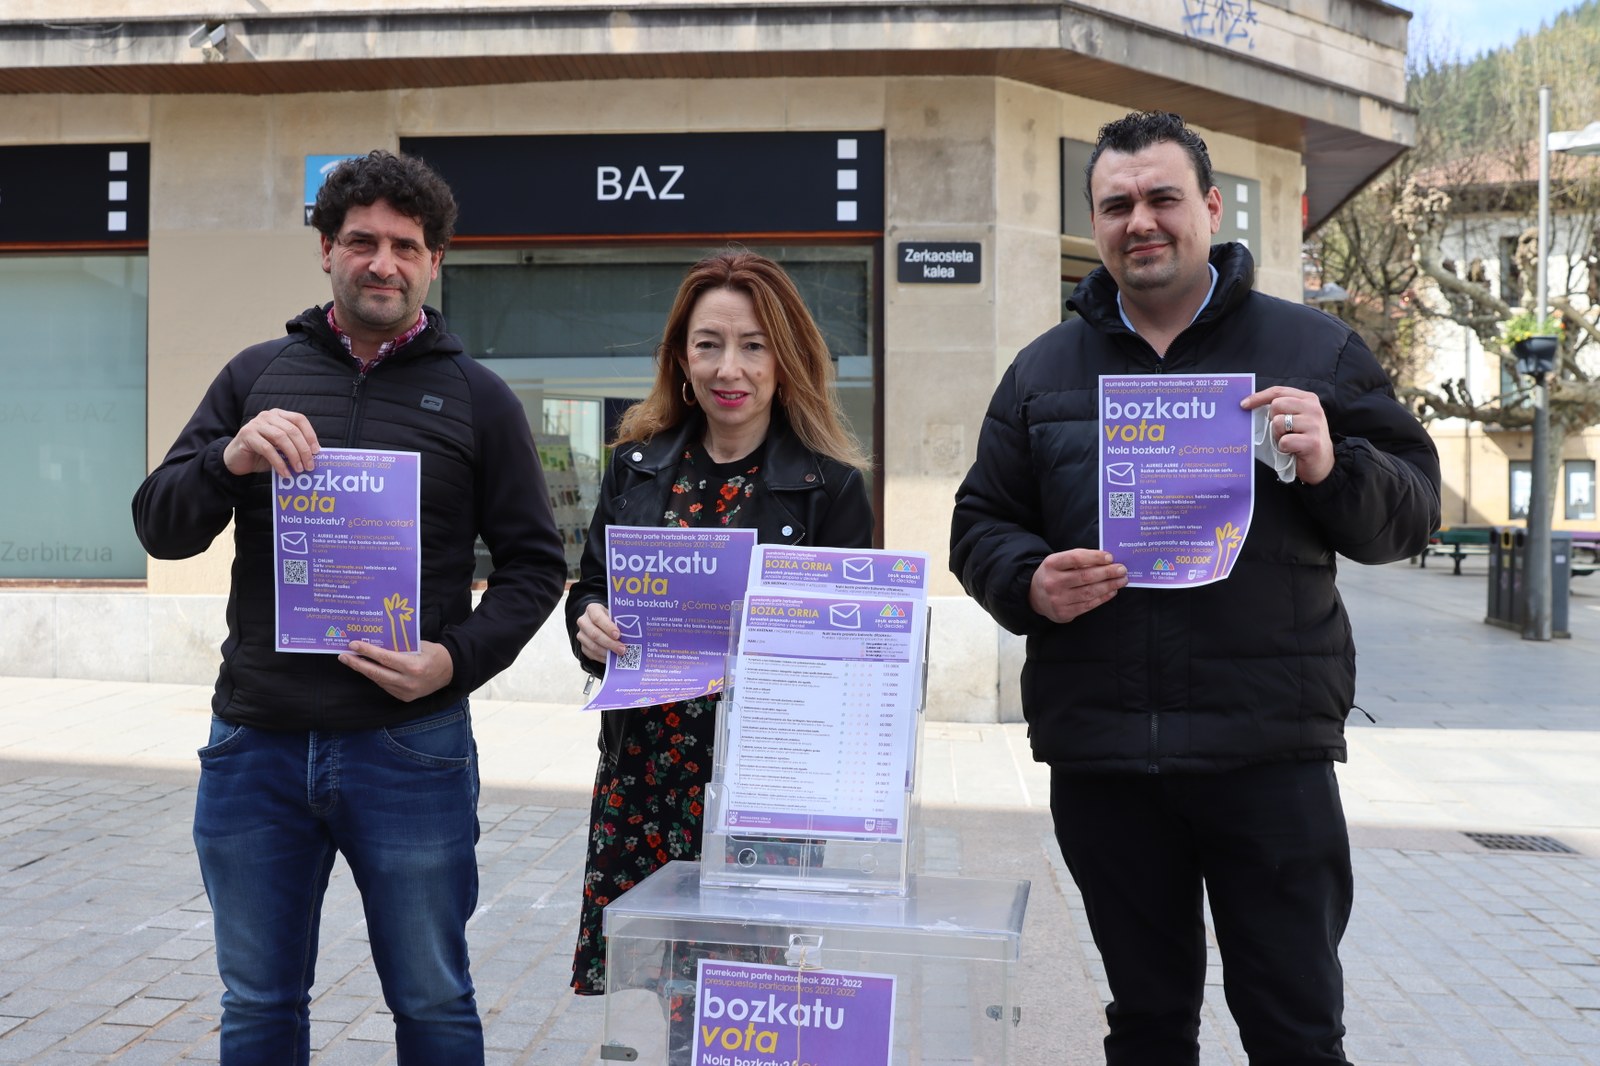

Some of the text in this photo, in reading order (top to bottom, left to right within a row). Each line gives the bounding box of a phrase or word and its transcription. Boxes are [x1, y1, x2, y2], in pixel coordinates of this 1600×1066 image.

[597, 165, 685, 200] BAZ
[904, 248, 974, 263] Zerkaosteta
[923, 264, 955, 278] kalea
[1106, 397, 1215, 419] bozkatu
[1105, 419, 1165, 442] vota
[1108, 445, 1248, 456] Nola bozkatu? ¿Cómo votar?
[278, 470, 384, 492] bozkatu
[278, 490, 335, 512] vota
[281, 515, 414, 528] Nola bozkatu? ¿Cómo votar?
[0, 541, 113, 562] Zerbitzua
[611, 548, 717, 574] bozkatu
[766, 560, 832, 571] BOZKA ORRIA
[612, 573, 668, 595] vota
[615, 598, 634, 606] Nola
[637, 598, 679, 608] bozkatu?
[682, 601, 716, 611] ¿Cómo
[751, 606, 819, 618] BOZKA ORRIA
[347, 624, 383, 633] 500.000€
[704, 978, 757, 990] presupuestos
[815, 986, 855, 997] 2021-2022
[706, 968, 749, 978] aurrekontu
[751, 972, 772, 982] parte
[821, 977, 863, 988] 2021-2022
[703, 988, 844, 1030] bozkatu
[701, 1023, 778, 1054] vota
[703, 1054, 730, 1066] Nola
